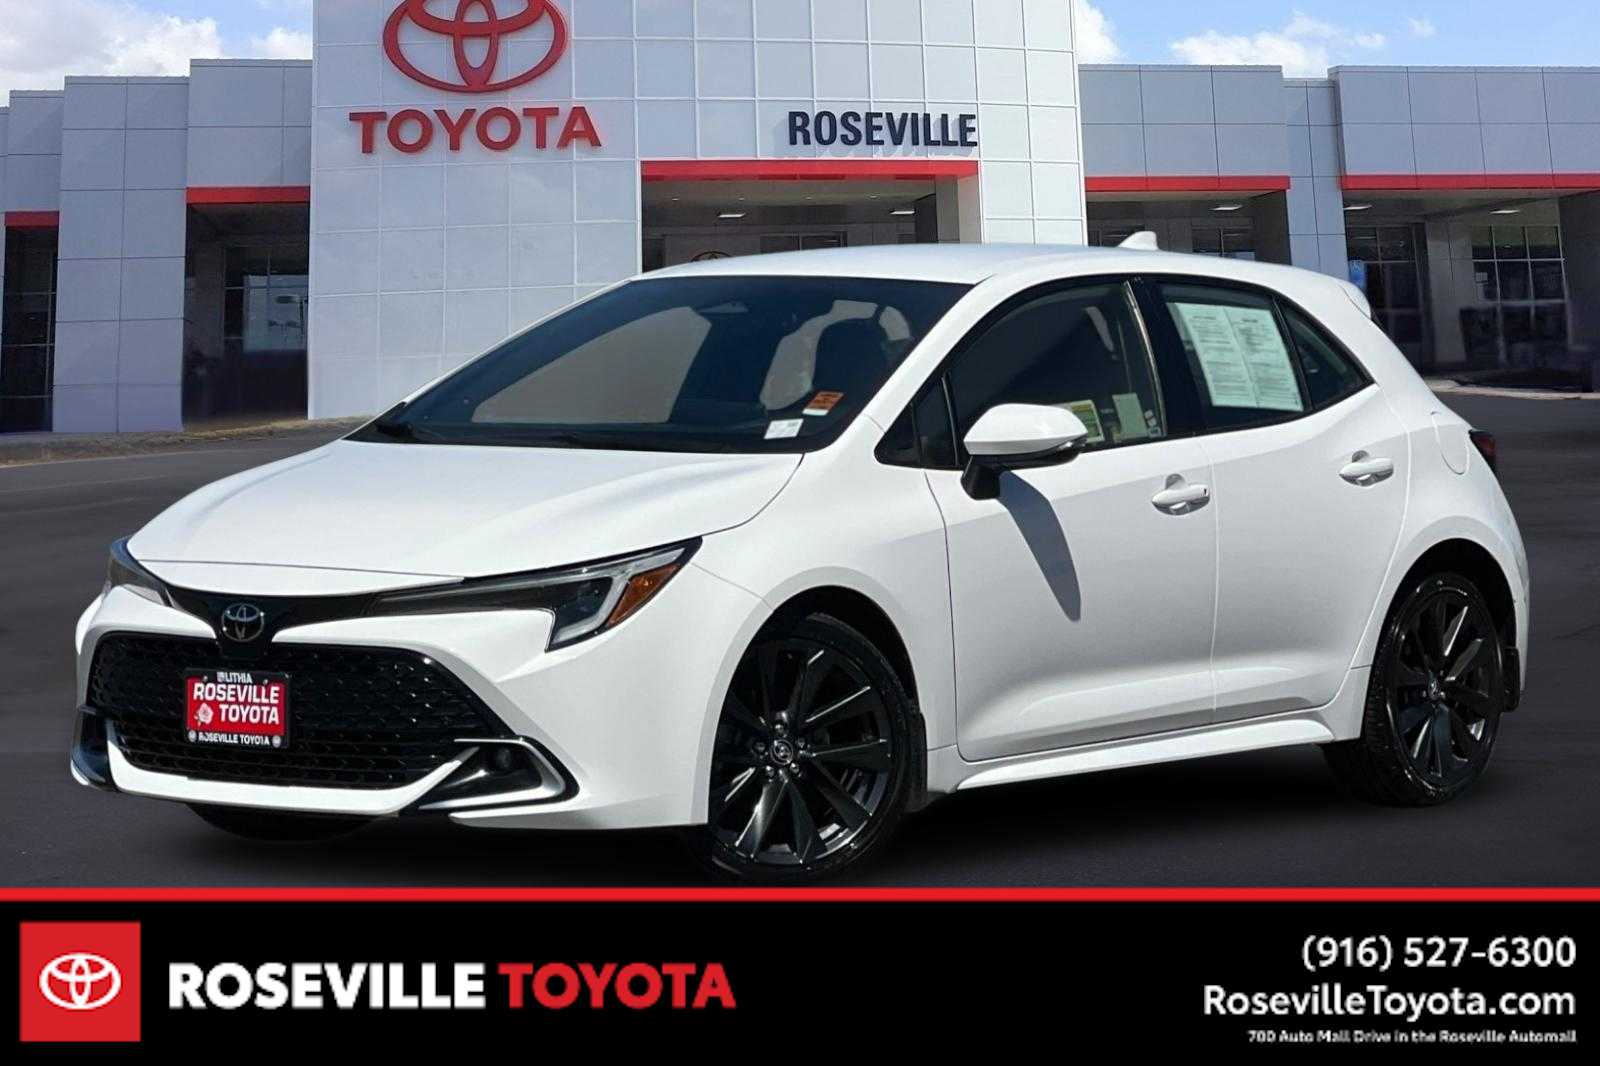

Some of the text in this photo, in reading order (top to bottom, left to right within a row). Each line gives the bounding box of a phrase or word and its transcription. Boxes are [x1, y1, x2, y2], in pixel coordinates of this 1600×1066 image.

[350, 106, 602, 154] TOYOTA
[788, 110, 978, 147] ROSEVILLE
[224, 672, 253, 684] LITHIA
[193, 682, 280, 704] ROSEVILLE
[219, 703, 280, 725] TOYOTA
[198, 732, 270, 746] ROSEVILLE TOYOTA
